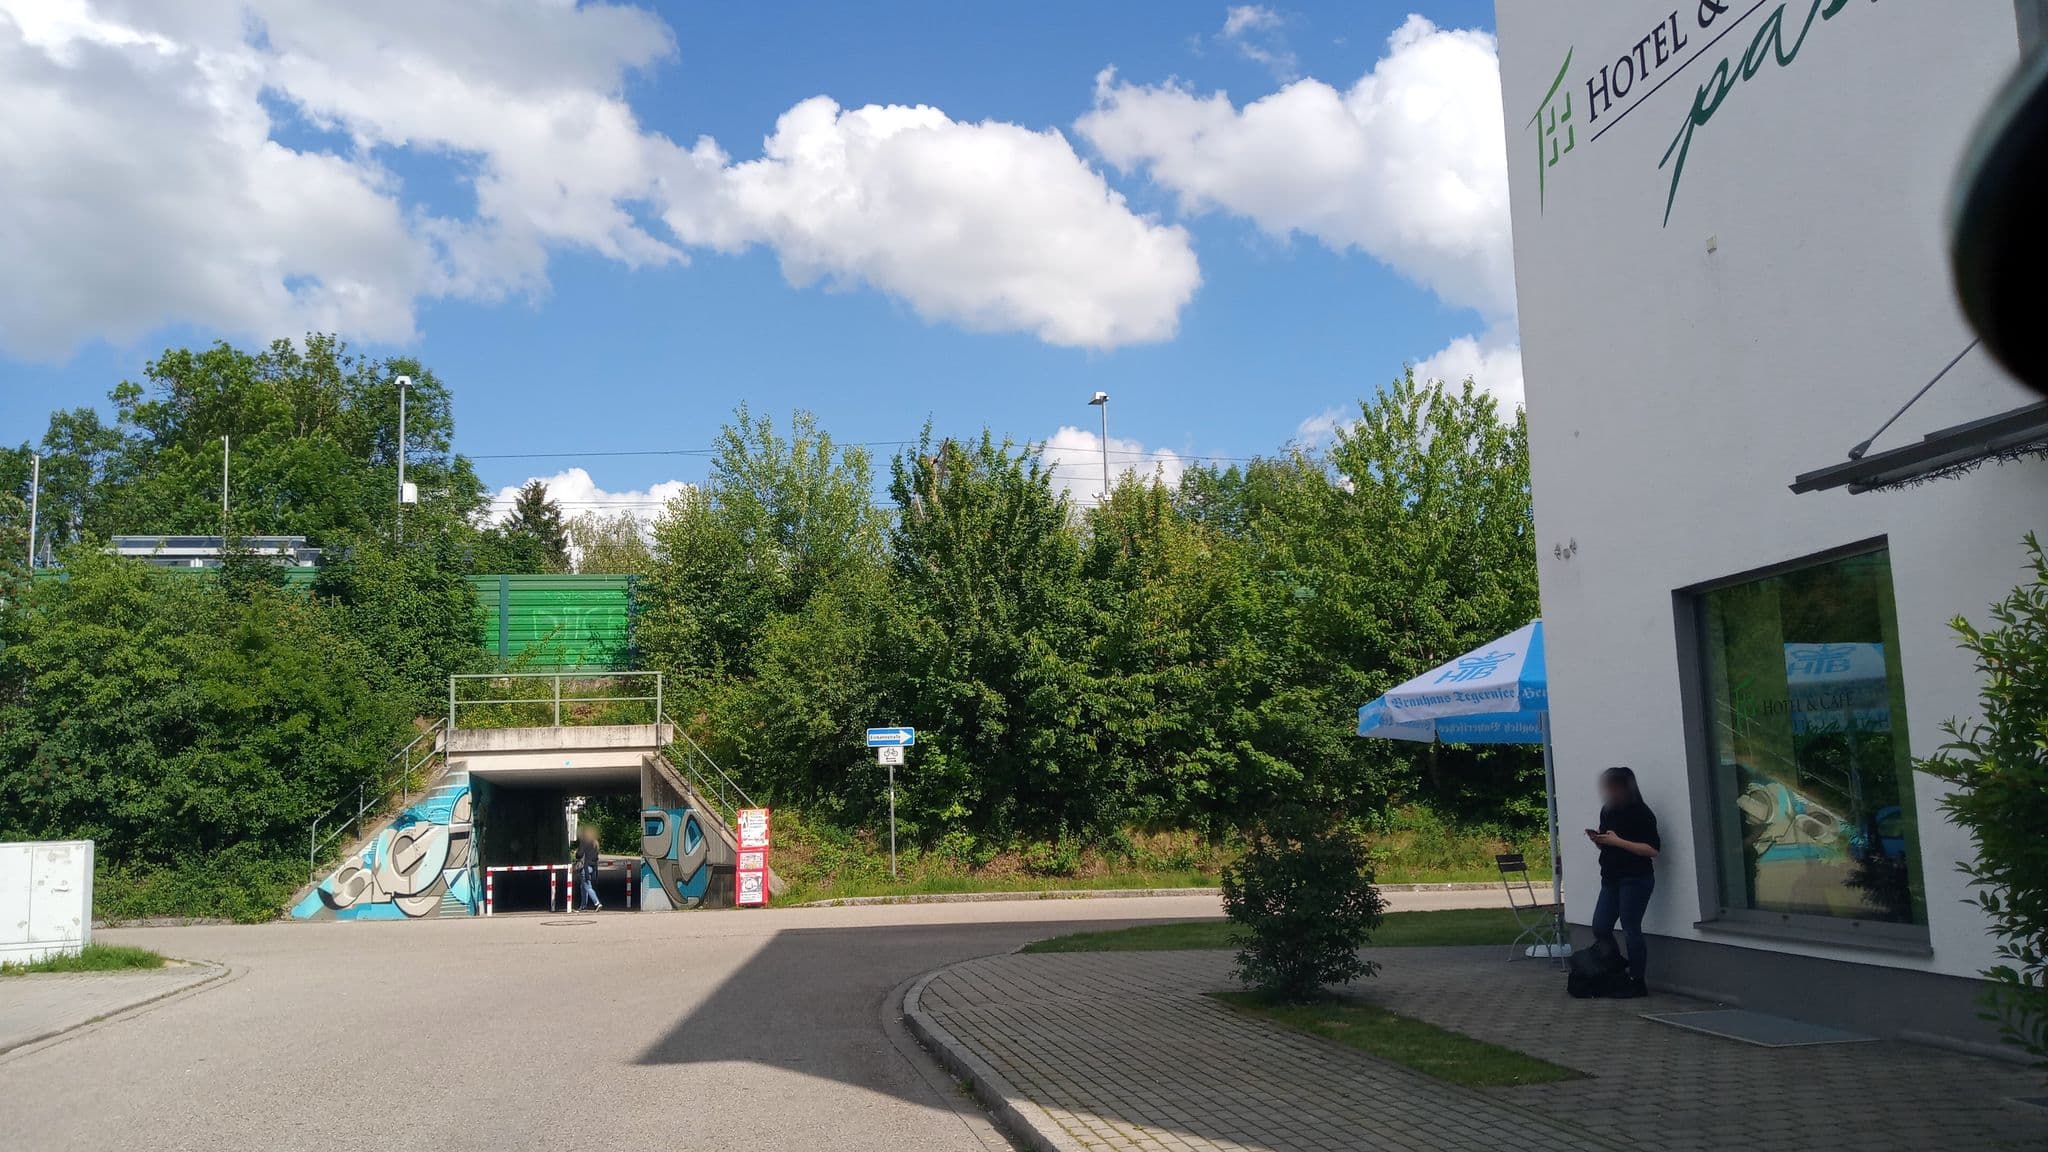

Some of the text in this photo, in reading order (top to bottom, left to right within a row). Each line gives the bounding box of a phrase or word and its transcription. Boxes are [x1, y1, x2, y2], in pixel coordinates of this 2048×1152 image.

[1587, 10, 1688, 123] HOTEL
[1658, 0, 1850, 228] pa
[1391, 694, 1452, 709] Brauhaus
[1762, 698, 1803, 715] HOTEL
